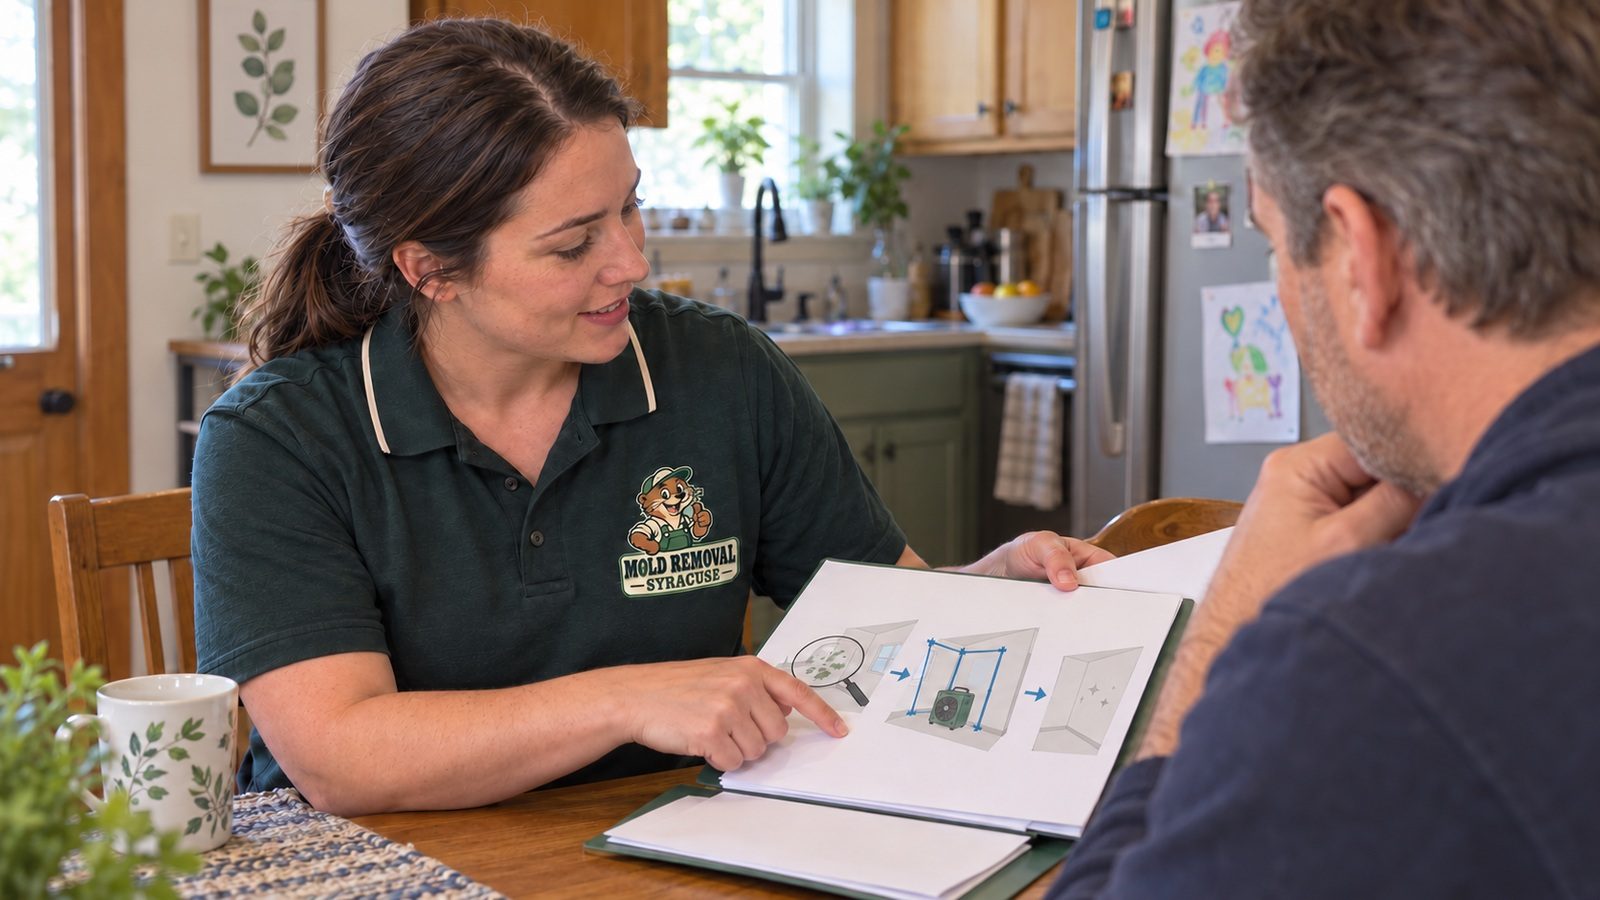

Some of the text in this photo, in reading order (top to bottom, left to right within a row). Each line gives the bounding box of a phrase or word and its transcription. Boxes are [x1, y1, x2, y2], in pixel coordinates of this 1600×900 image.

[624, 544, 736, 580] MOLD REMOVAL
[646, 568, 720, 591] SYRACUSE
